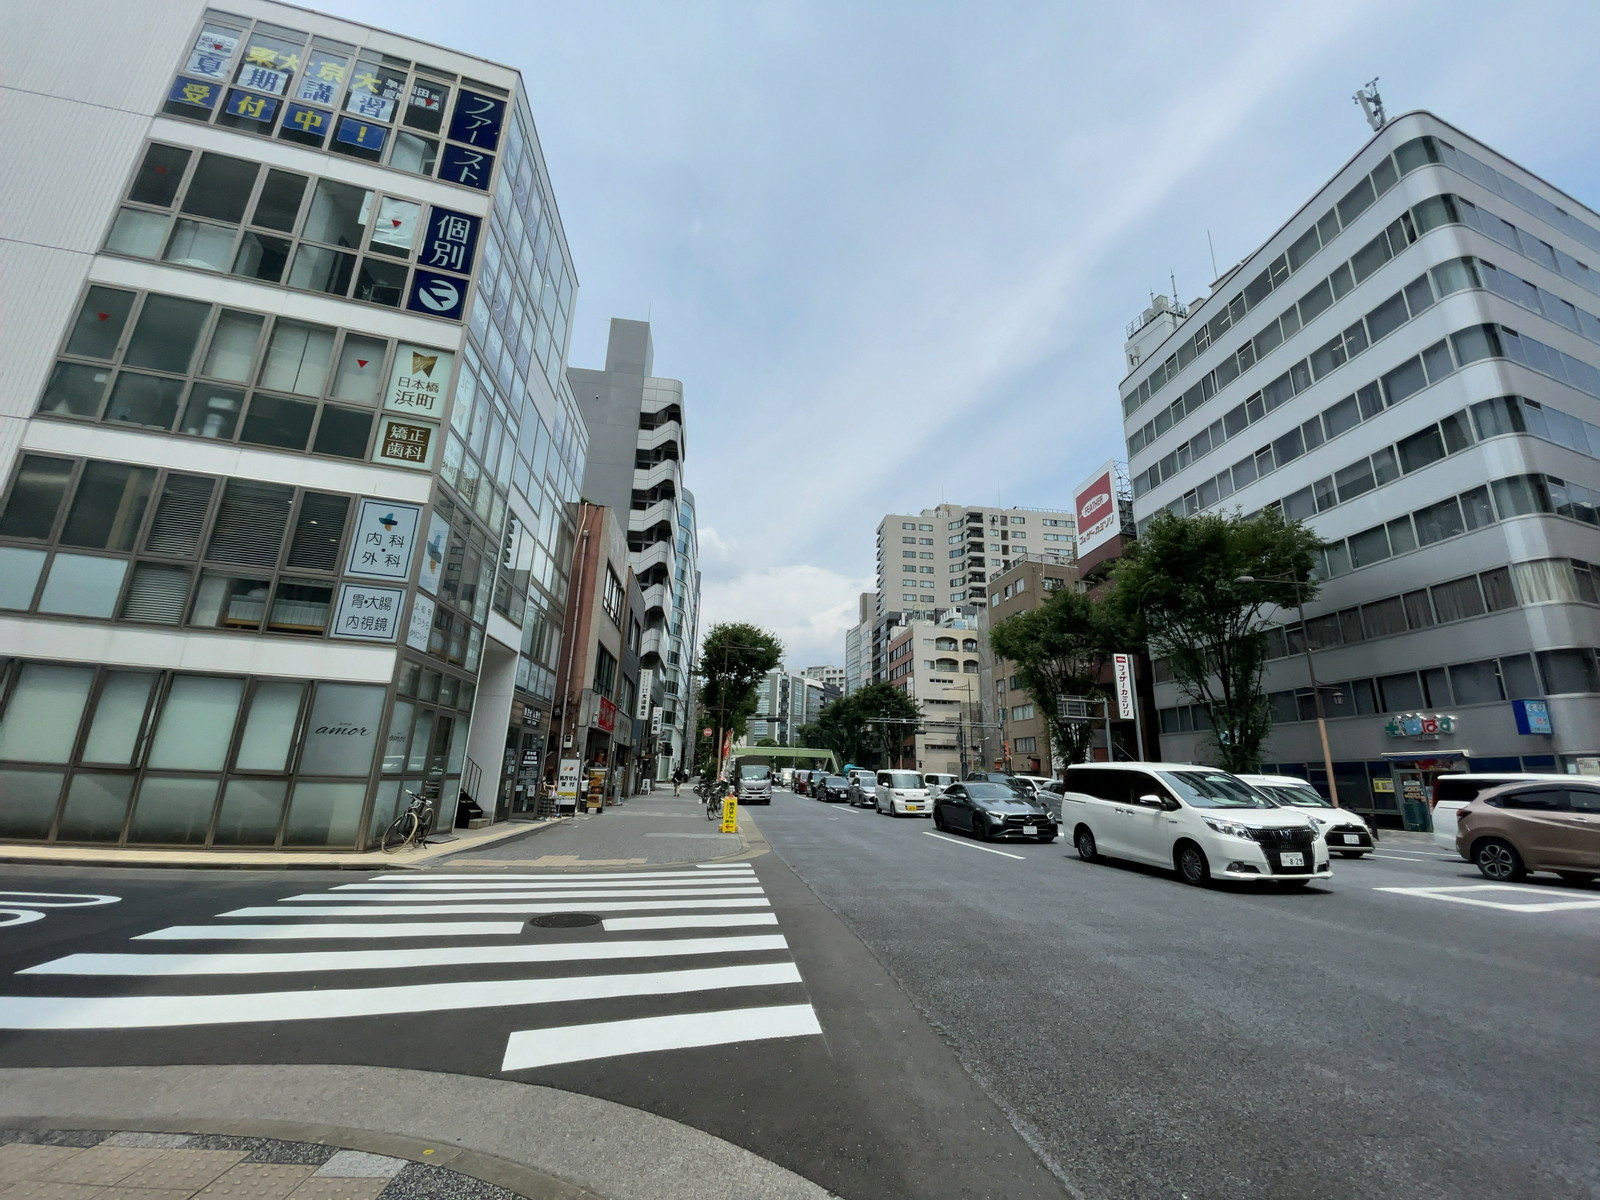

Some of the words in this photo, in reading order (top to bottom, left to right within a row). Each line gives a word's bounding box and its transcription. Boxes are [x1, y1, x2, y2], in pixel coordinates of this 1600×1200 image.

[429, 214, 471, 270] 個別
[398, 376, 440, 393] 日本橋
[394, 389, 436, 410] 浜町
[389, 425, 426, 443] 矯正
[386, 442, 422, 460] 歯科
[1085, 495, 1103, 516] FEATHER
[1079, 514, 1114, 545] フェザーカミソリ
[345, 615, 388, 632] 内視鏡
[1118, 664, 1129, 717] フェザーカミソリ
[315, 726, 370, 736] amor
